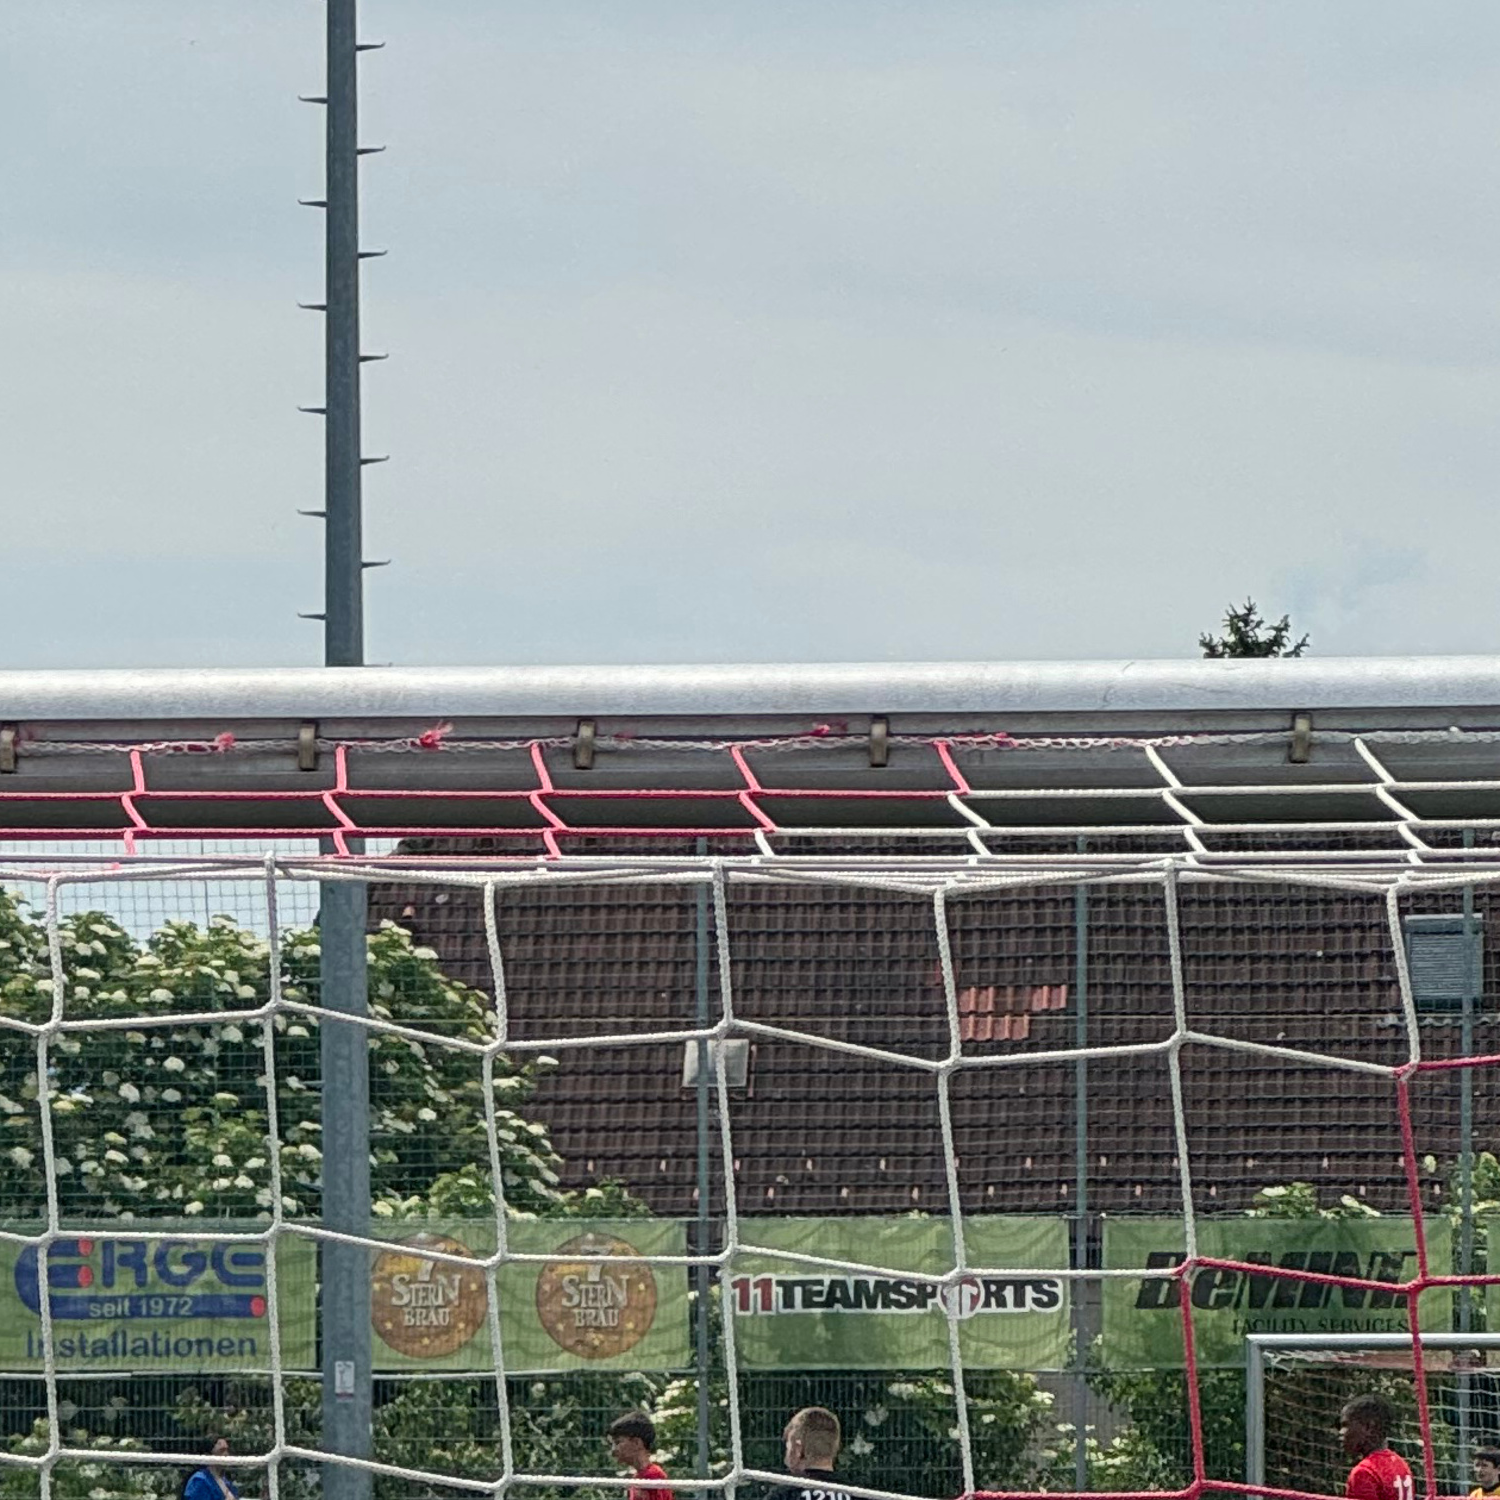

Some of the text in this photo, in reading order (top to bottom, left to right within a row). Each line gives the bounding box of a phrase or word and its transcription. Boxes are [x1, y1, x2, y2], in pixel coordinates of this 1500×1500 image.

[391, 1274, 461, 1307] STERN
[562, 1274, 630, 1307] STERN
[90, 1298, 193, 1318] seit 1972
